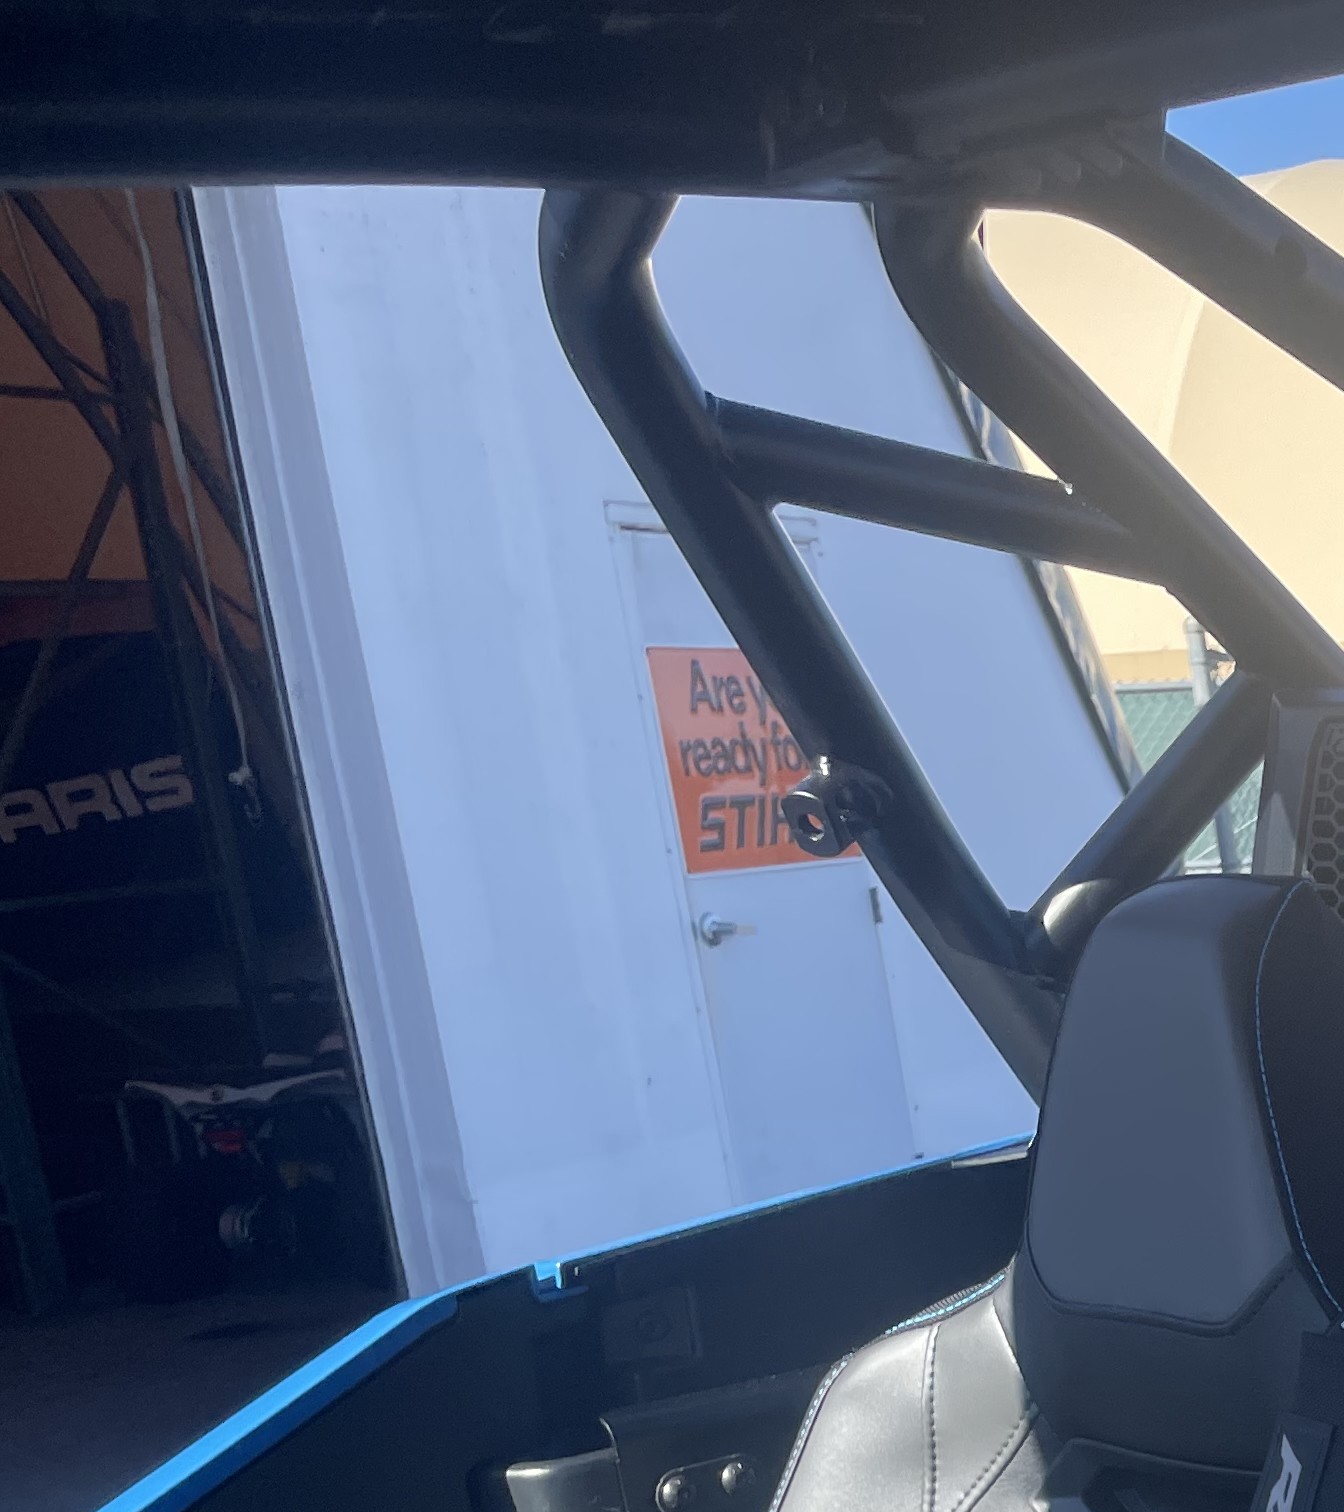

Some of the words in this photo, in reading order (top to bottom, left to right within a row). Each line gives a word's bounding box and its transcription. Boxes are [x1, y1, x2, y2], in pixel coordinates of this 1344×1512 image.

[691, 659, 747, 714] Are
[680, 722, 767, 786] ready
[770, 721, 811, 771] fo
[700, 793, 797, 852] STIH
